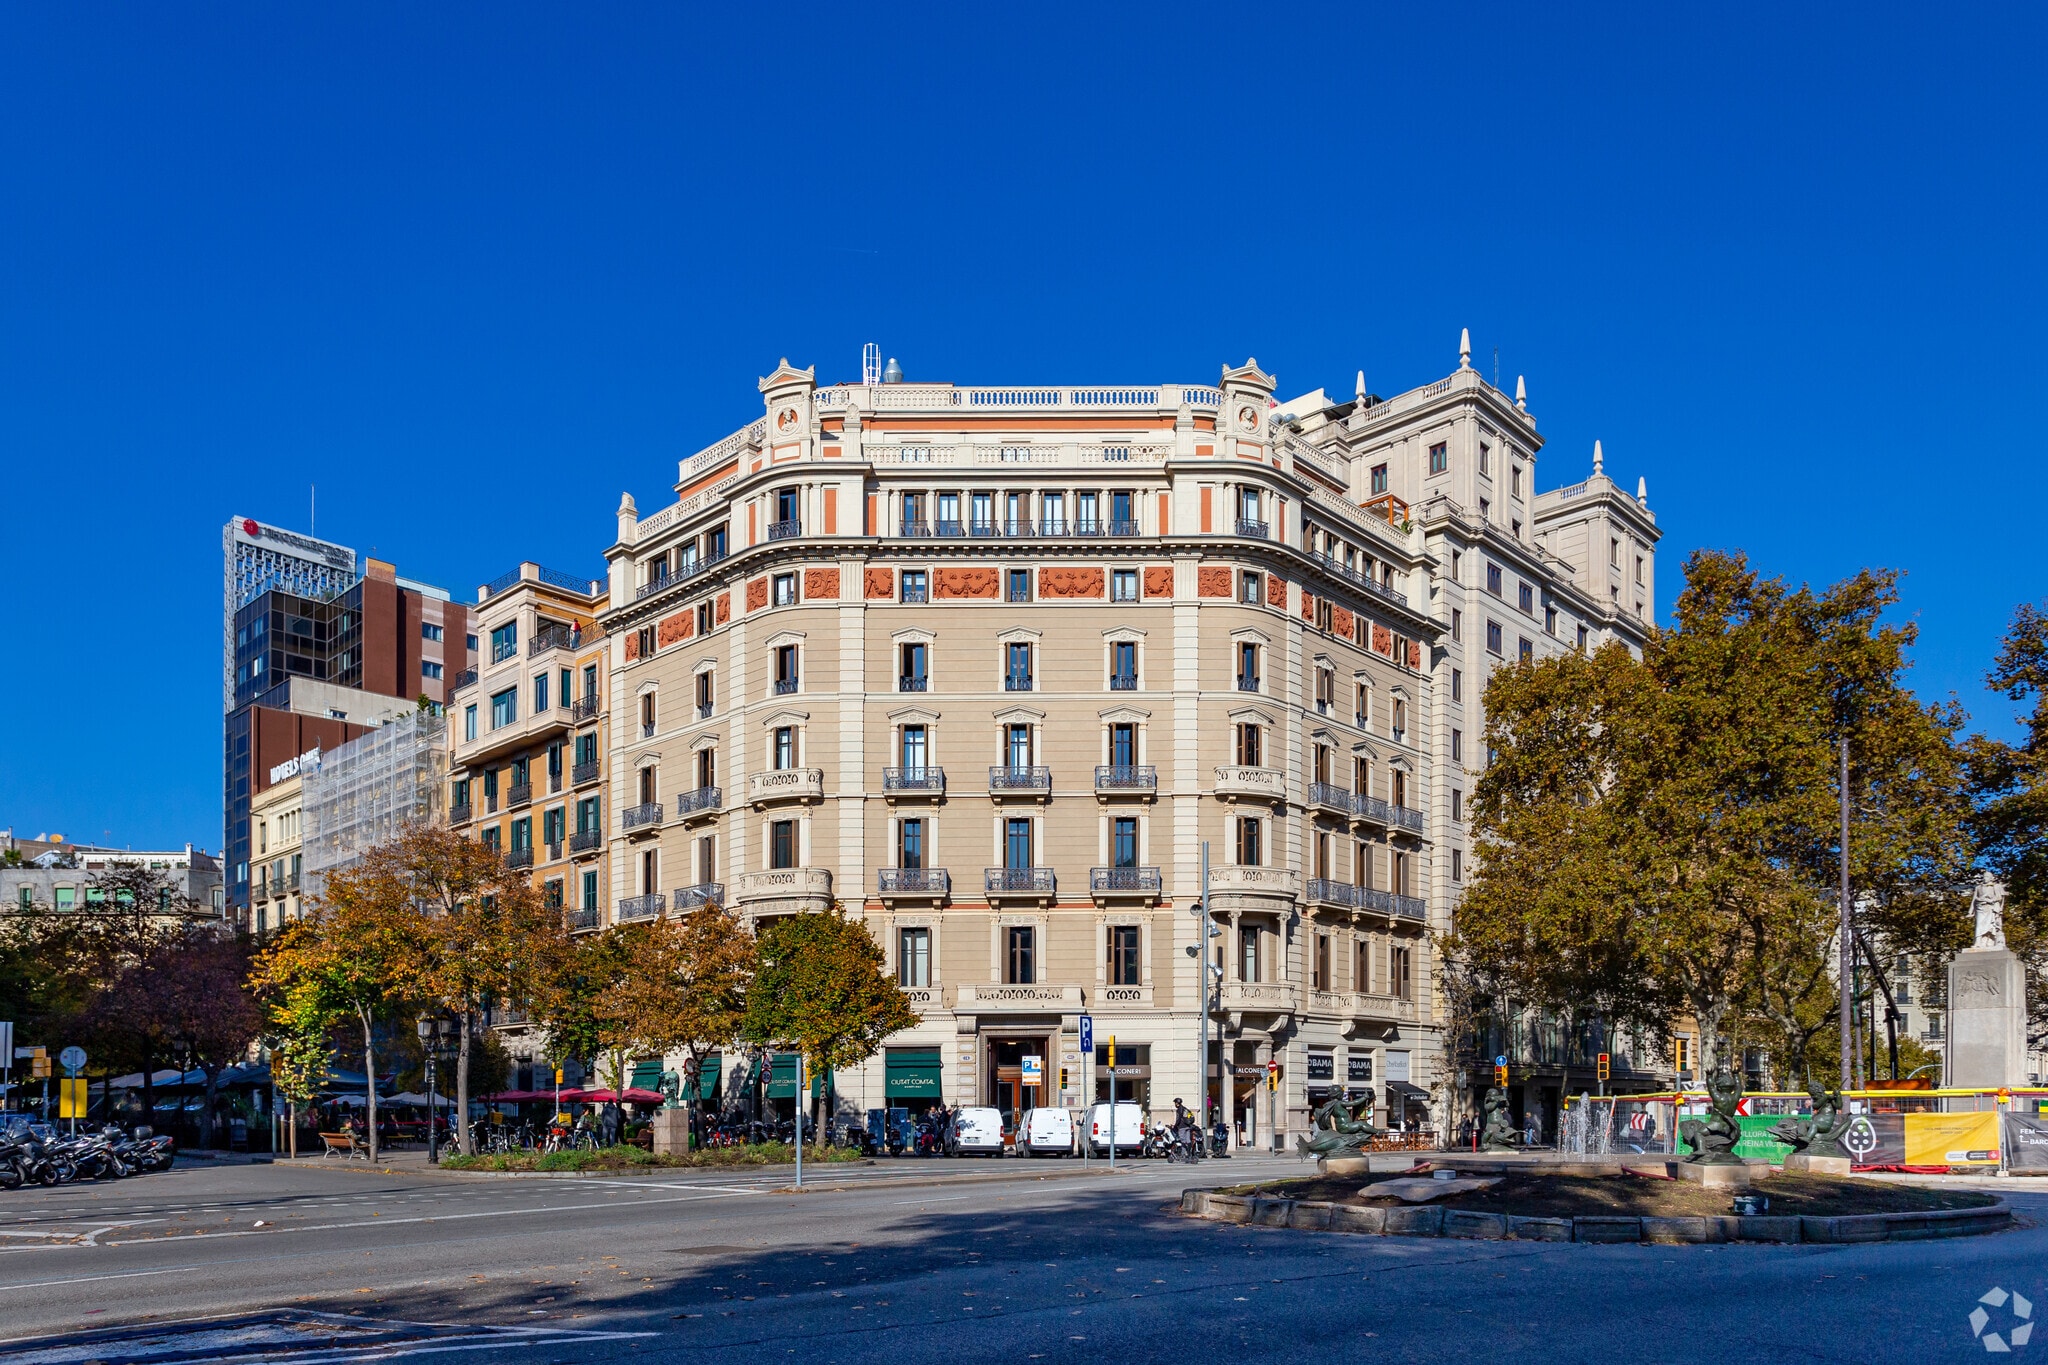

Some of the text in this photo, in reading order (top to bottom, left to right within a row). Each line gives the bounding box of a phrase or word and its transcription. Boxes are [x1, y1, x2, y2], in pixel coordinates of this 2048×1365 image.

[1082, 1018, 1090, 1038] P
[1025, 1061, 1031, 1069] P
[1308, 1058, 1333, 1067] OBAMA
[1348, 1061, 1371, 1069] OBAMA
